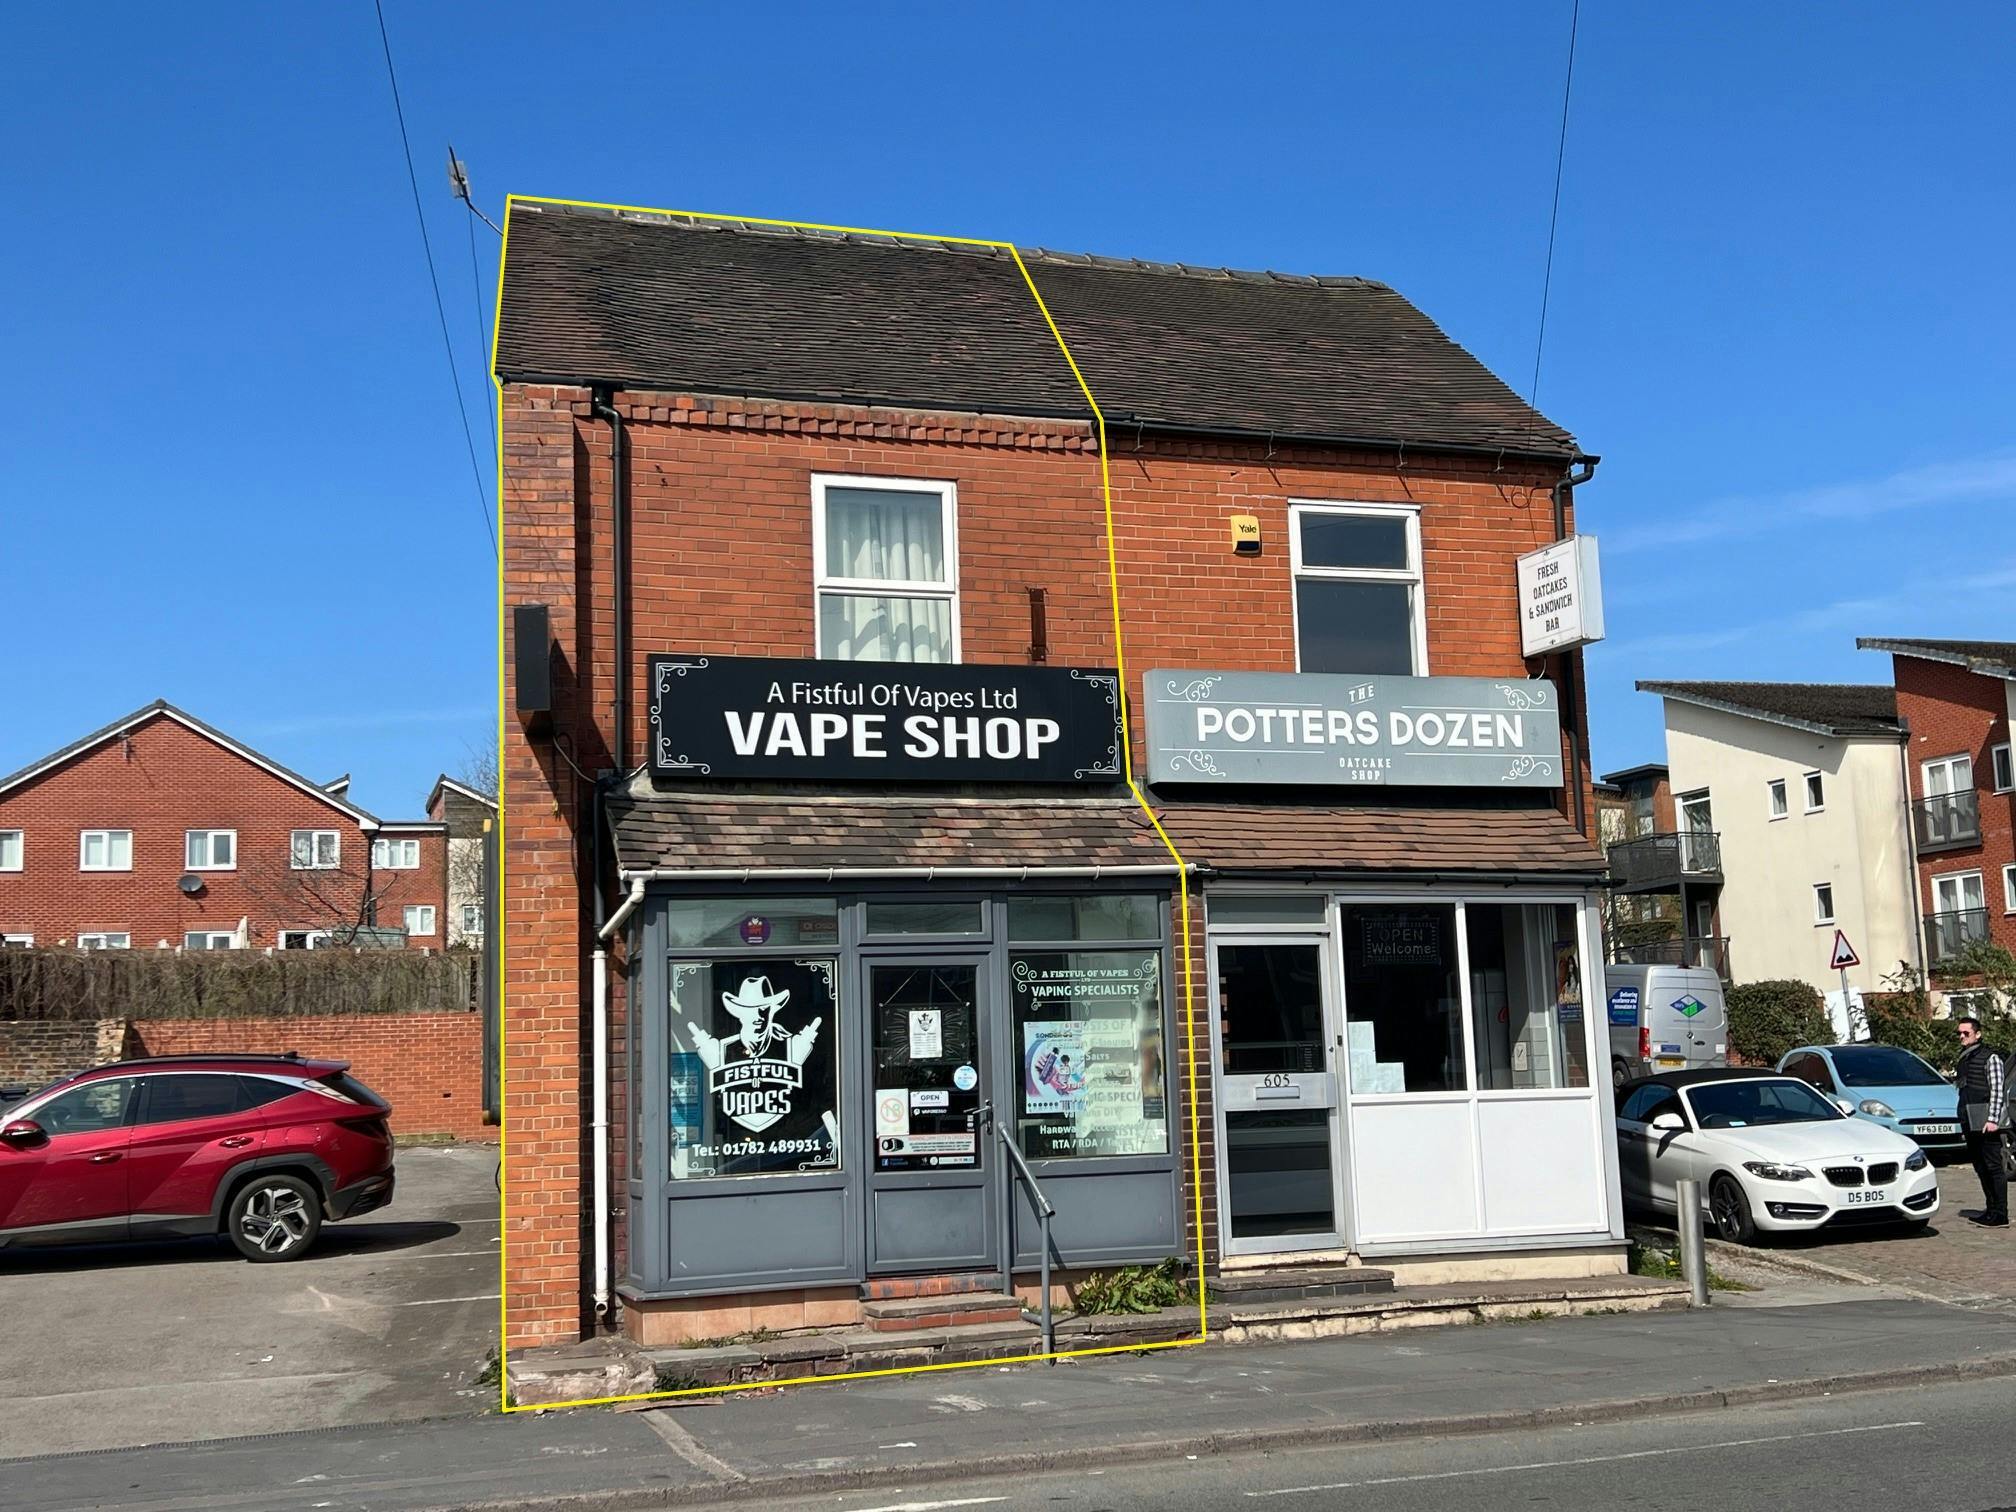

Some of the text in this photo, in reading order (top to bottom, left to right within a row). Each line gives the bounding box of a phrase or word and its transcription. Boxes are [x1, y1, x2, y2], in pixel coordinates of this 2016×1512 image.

[1239, 524, 1257, 533] Yale
[1537, 561, 1559, 580] FRESH
[1533, 577, 1568, 600] OATCAKES
[1529, 593, 1573, 619] & SANDWICH
[1545, 617, 1560, 632] BAR
[767, 681, 1018, 713] A Fistful Of Vapes Ltd
[1348, 685, 1376, 703] THE
[1197, 707, 1524, 748] POTTERS DOZEN
[723, 710, 1060, 760] VAPE SHOP
[1339, 757, 1392, 769] OATCAKE
[1351, 769, 1381, 781] SHOP
[1379, 928, 1424, 941] OPEN
[1371, 942, 1432, 955] Welcome
[1042, 970, 1049, 978] A
[1050, 970, 1086, 978] FISTFUL
[1101, 969, 1129, 977] VAPES
[1031, 984, 1140, 997] VAPING SPECIALISTS
[724, 1064, 793, 1083] FISTFUL
[752, 1078, 763, 1088] OF
[1264, 1074, 1290, 1088] 605
[722, 1088, 792, 1116] VAPES
[920, 1094, 940, 1102] OPEN
[1917, 1125, 1937, 1133] YF63
[723, 1140, 766, 1156] 01782
[768, 1138, 821, 1154] 489931
[1052, 1140, 1070, 1149] RTA
[1865, 1190, 1885, 1202] BOS
